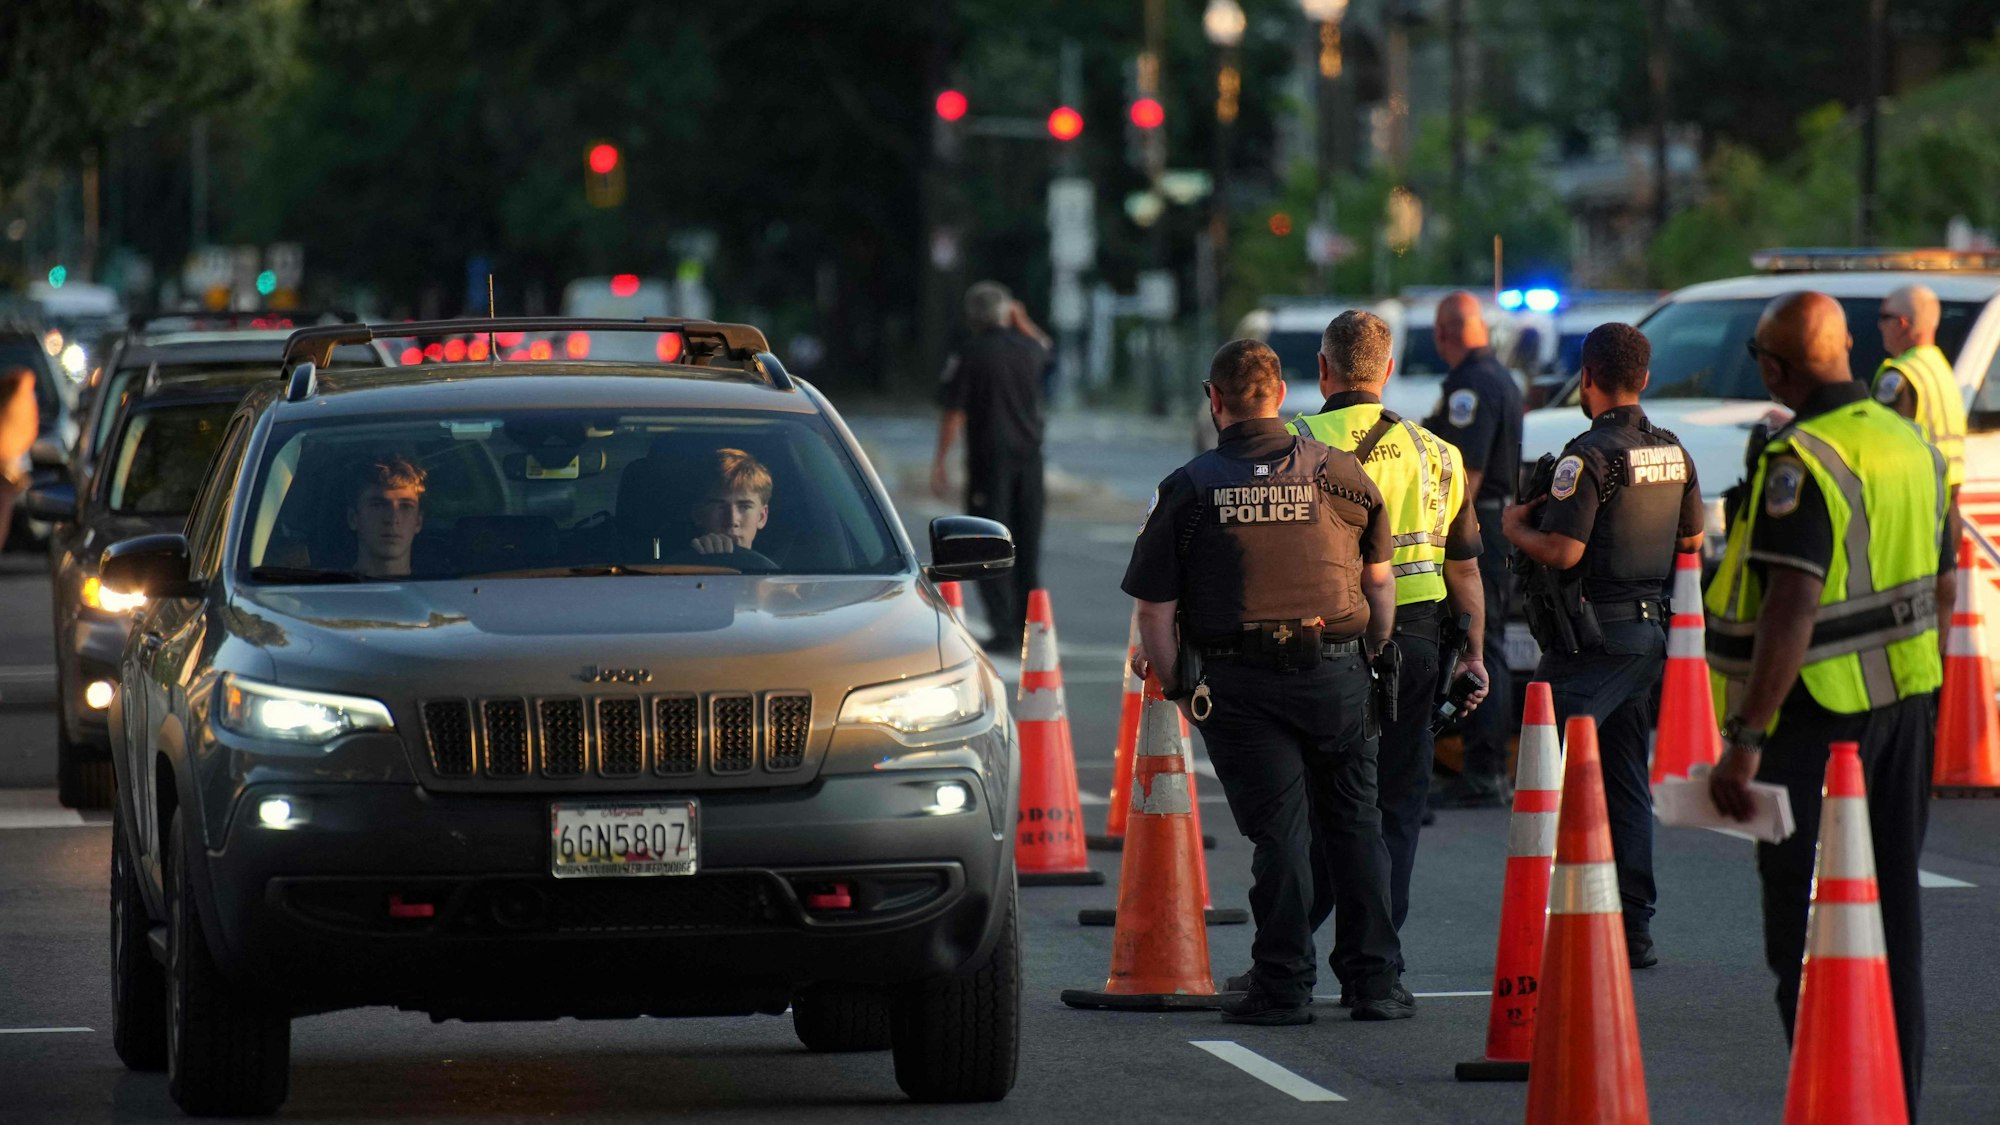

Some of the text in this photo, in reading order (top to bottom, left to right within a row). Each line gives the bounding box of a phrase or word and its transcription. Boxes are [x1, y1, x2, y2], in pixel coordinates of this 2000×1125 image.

[1365, 443, 1402, 464] AFFIC
[1635, 463, 1687, 484] POLICE
[1214, 485, 1313, 506] METROPOLITAN
[1219, 503, 1310, 524] POLICE
[577, 665, 654, 686] Jeep
[560, 822, 686, 858] 6GN5807
